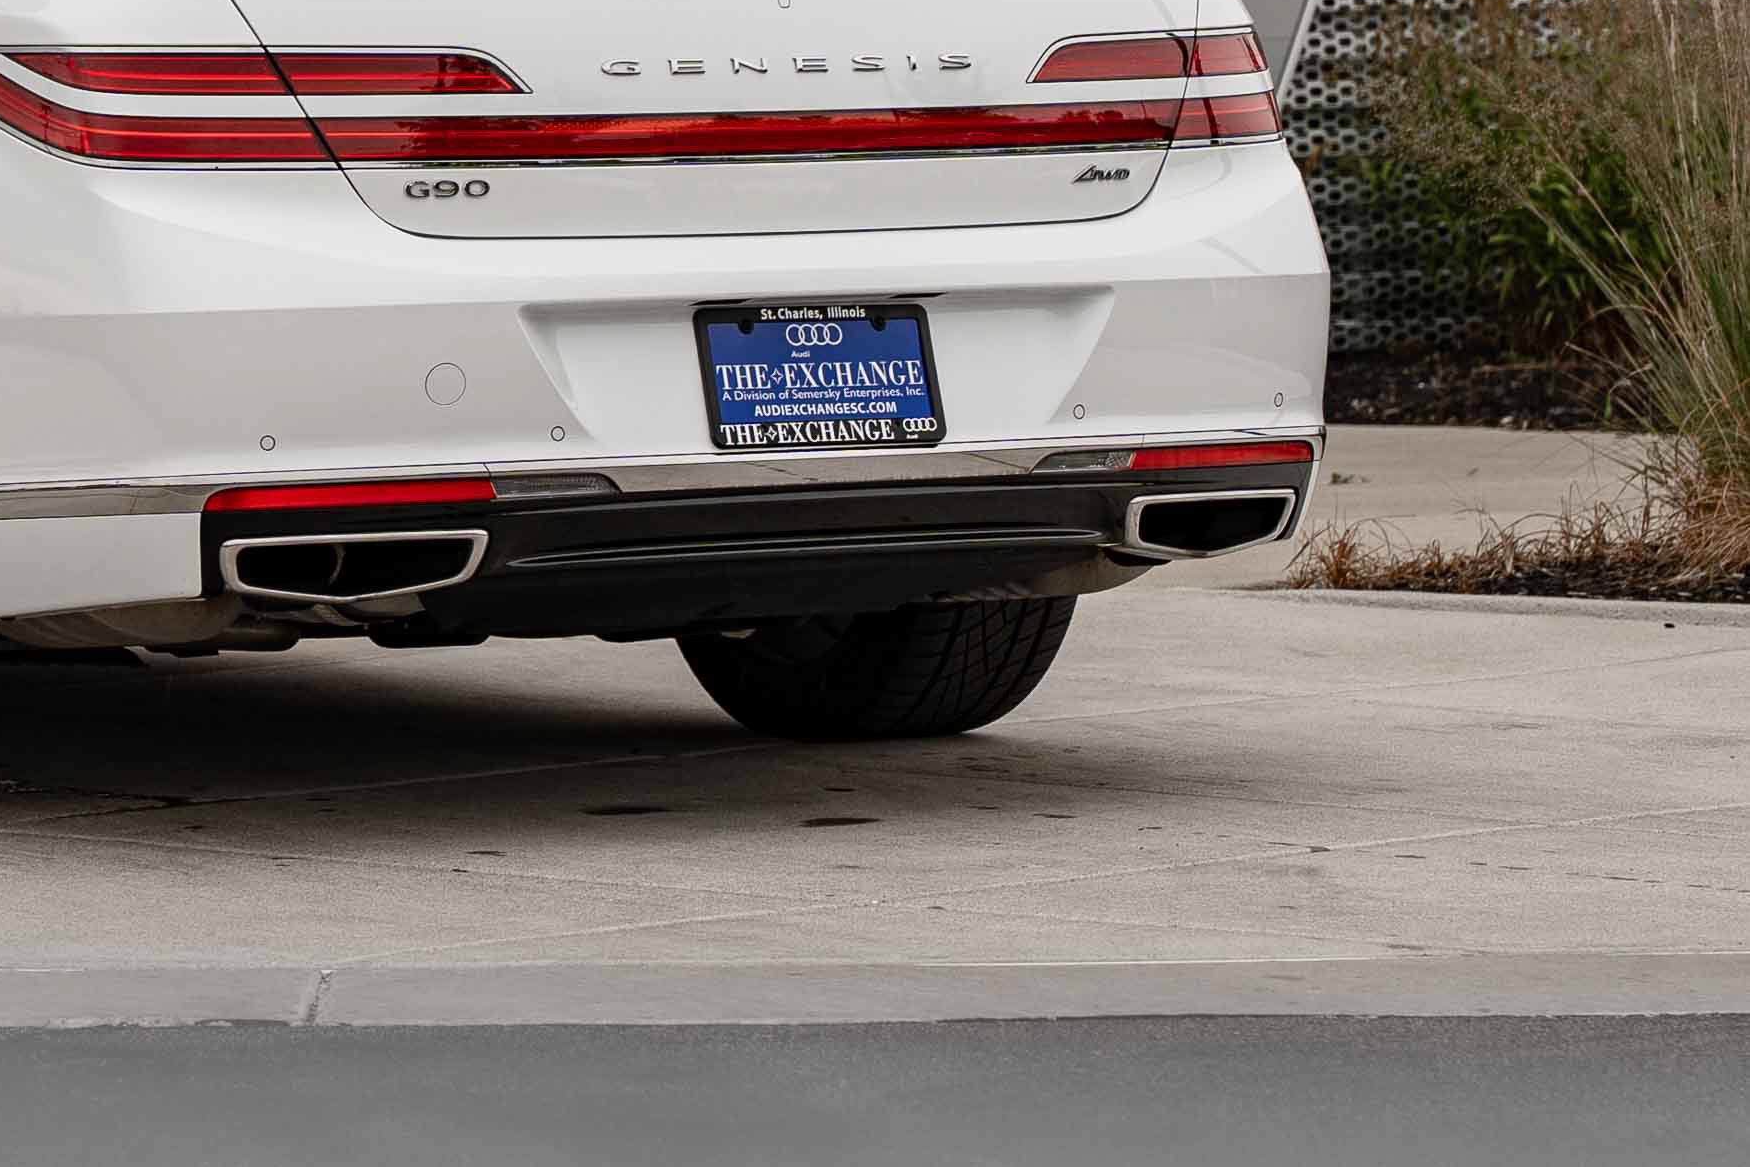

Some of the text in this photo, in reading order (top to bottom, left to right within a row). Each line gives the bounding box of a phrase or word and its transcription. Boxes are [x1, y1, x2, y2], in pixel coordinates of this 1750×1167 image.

[600, 53, 972, 76] GENESIS
[404, 179, 491, 198] G90
[761, 306, 866, 321] St. Charles, Illinois
[791, 350, 811, 358] Audi
[716, 360, 923, 391] THE EXCHANGE
[722, 391, 732, 401] A
[734, 390, 776, 401] Division
[778, 389, 789, 400] of
[906, 386, 925, 396] Inc.
[755, 402, 898, 417] AUDIEXCHANGESC.COM
[720, 419, 895, 446] THE EXCHANGE
